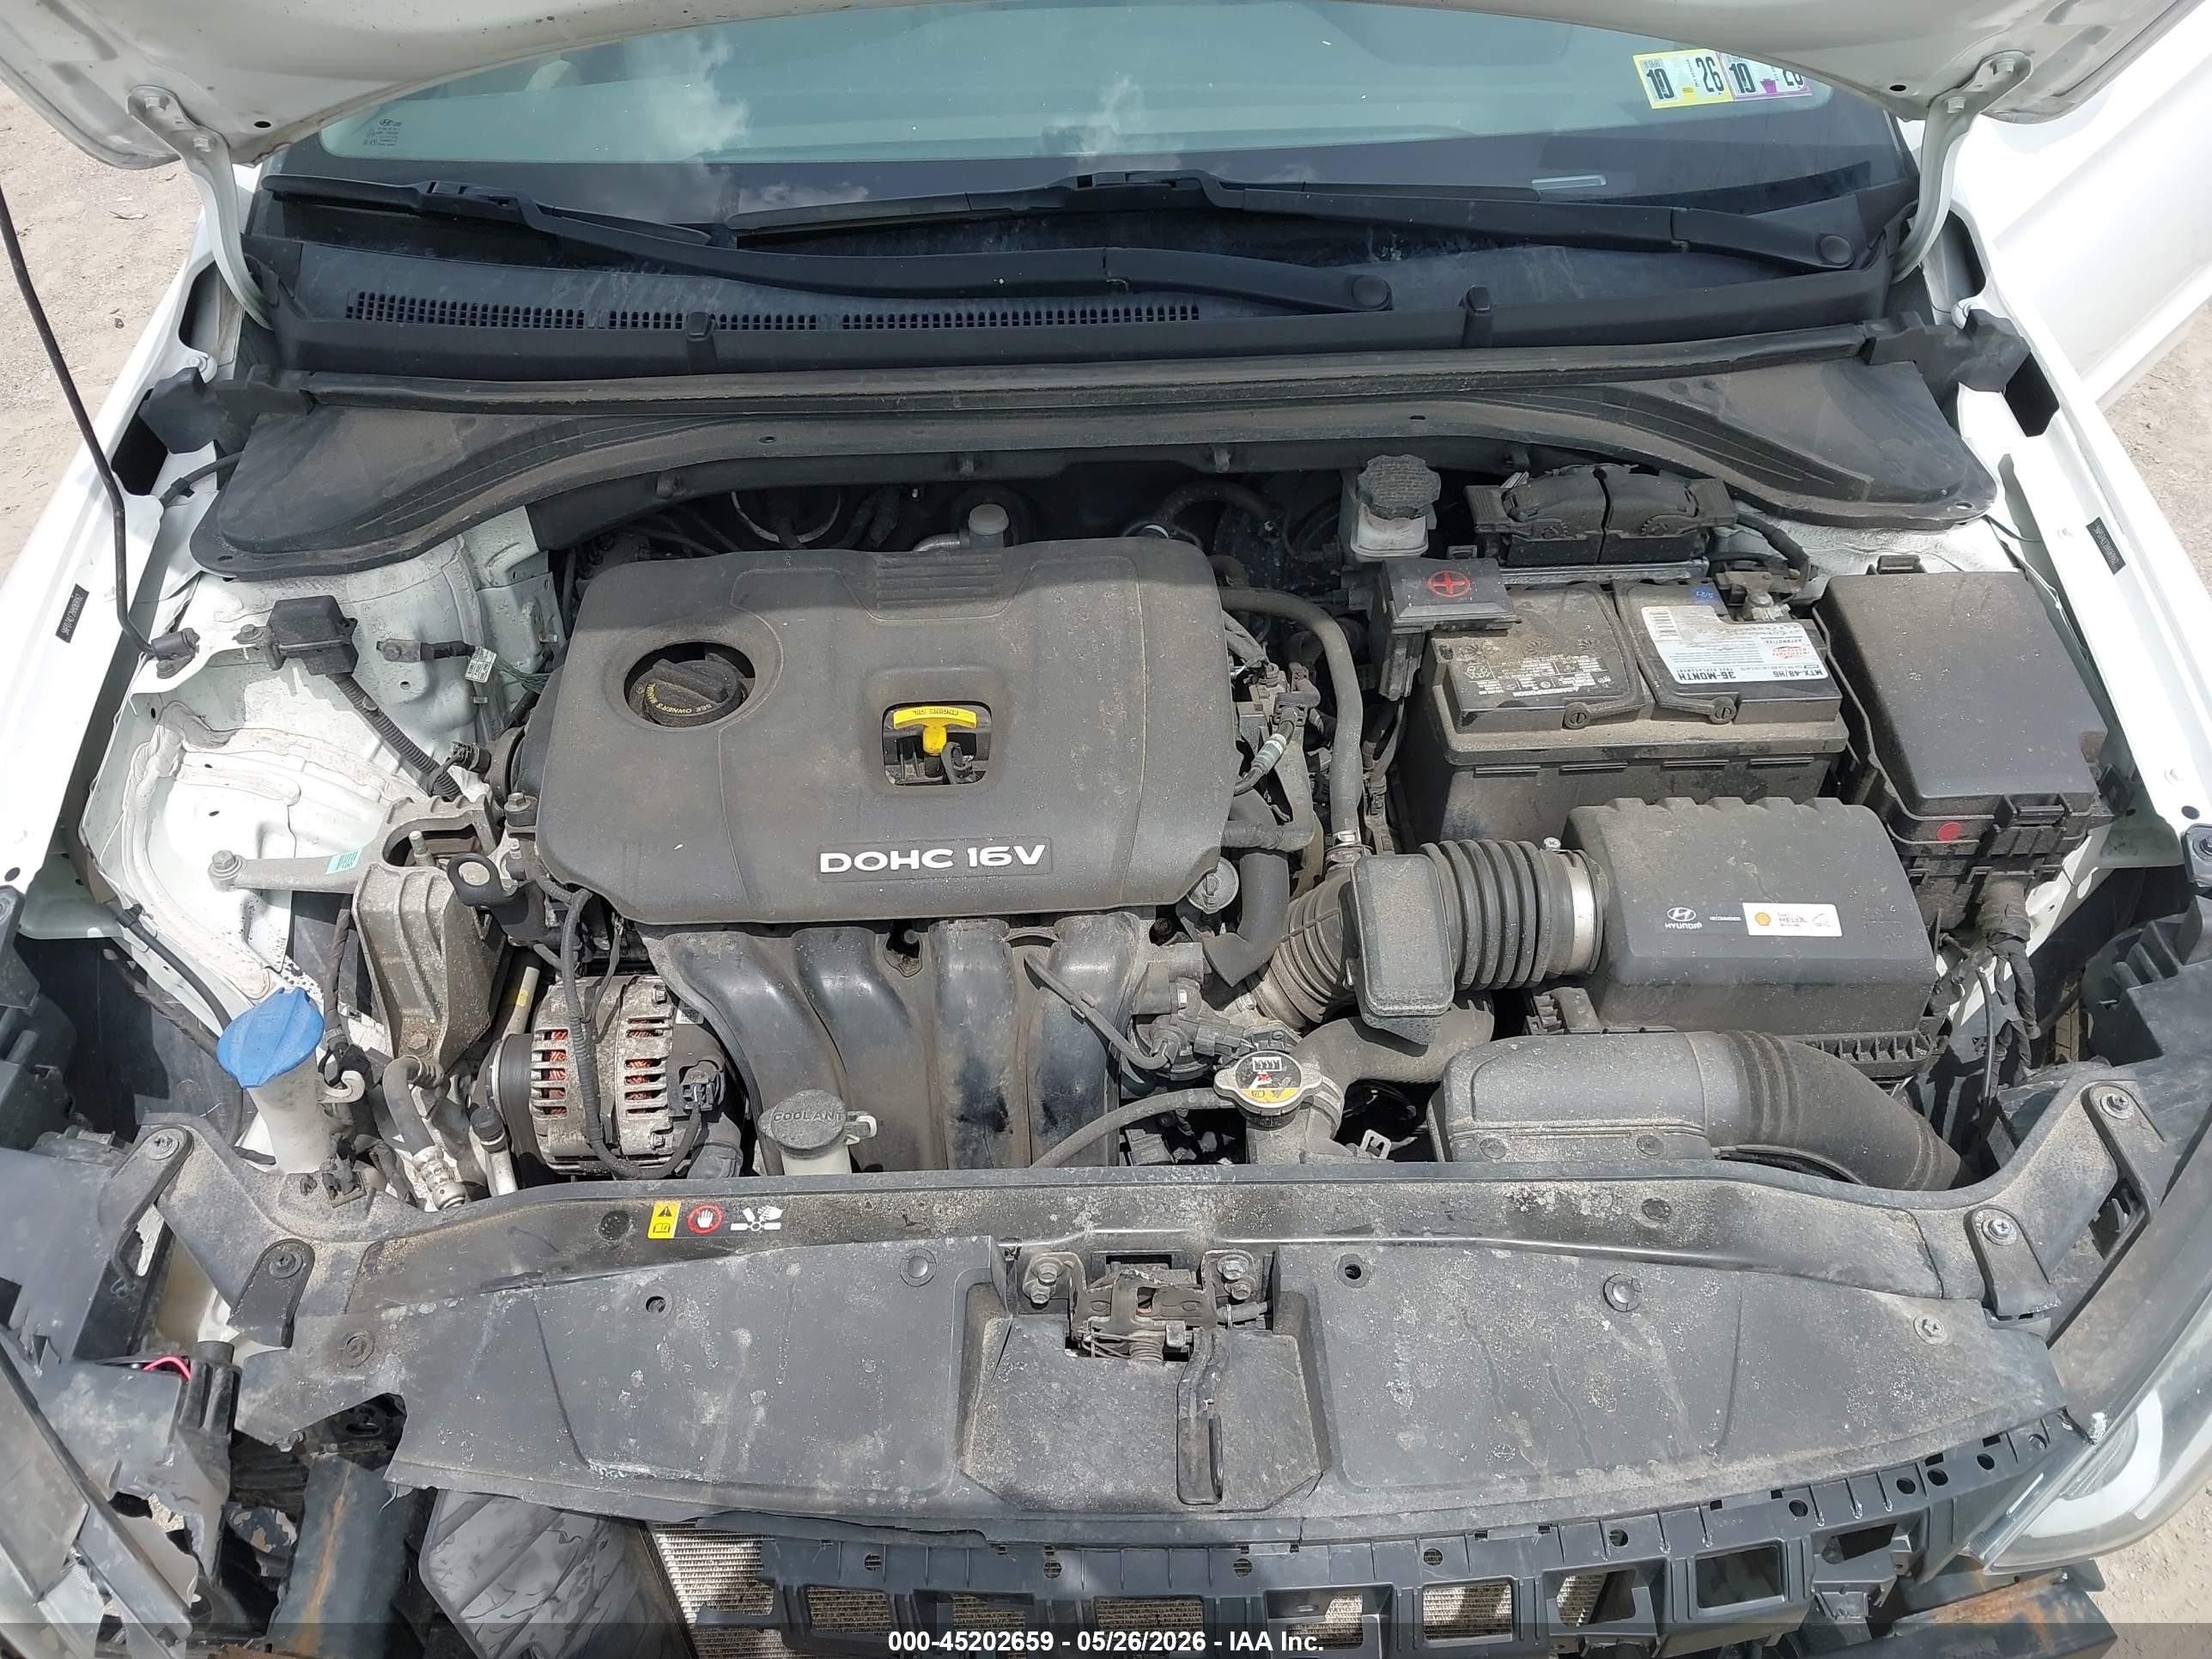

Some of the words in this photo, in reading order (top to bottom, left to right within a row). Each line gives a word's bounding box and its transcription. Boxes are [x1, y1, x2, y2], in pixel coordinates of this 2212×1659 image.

[1646, 68, 1675, 100] 10
[1695, 56, 1724, 92] 26
[1729, 63, 1756, 94] 10
[1679, 672, 1736, 680] 36-MONTH
[696, 703, 713, 713] SEE
[820, 848, 954, 873] DOHC
[967, 844, 1045, 867] 16V
[1664, 921, 1703, 930] HYUNDAI
[773, 1110, 843, 1121] COOLANT
